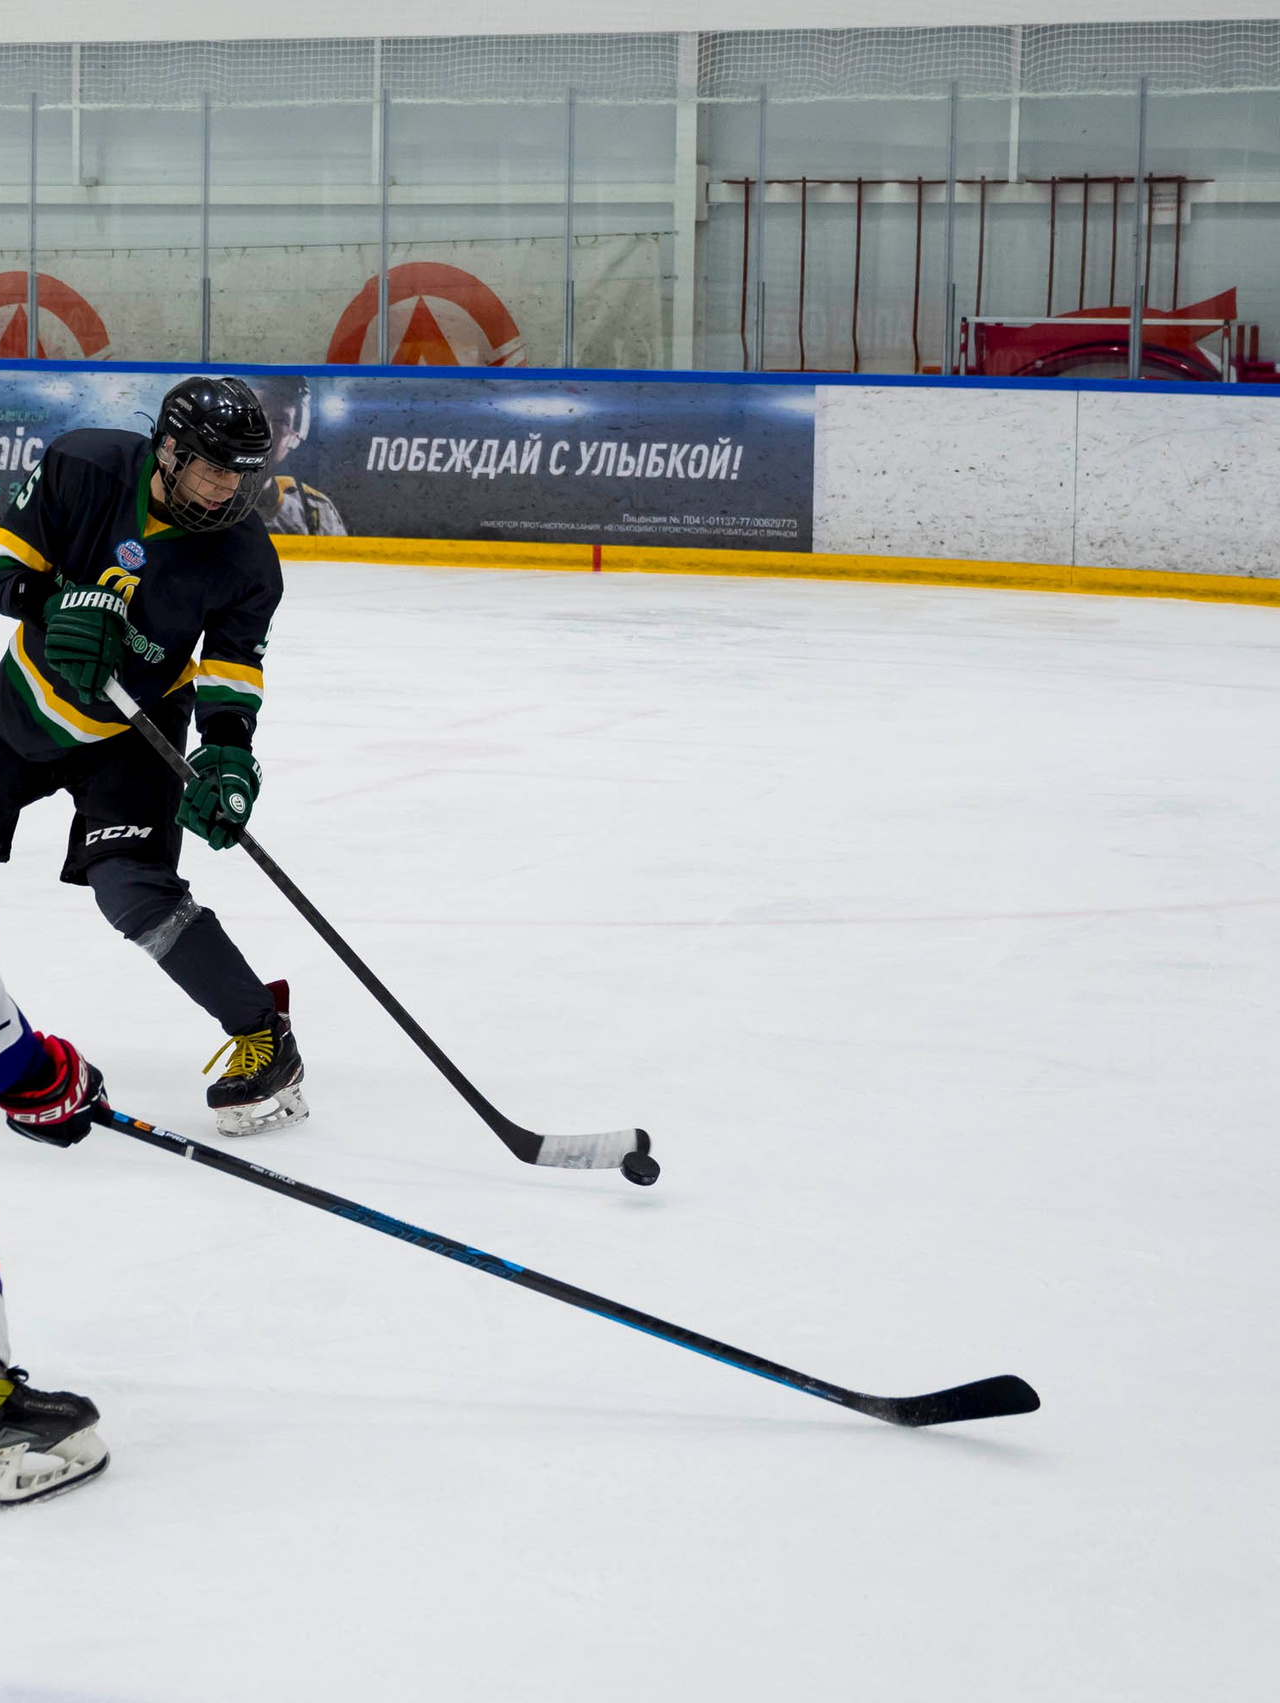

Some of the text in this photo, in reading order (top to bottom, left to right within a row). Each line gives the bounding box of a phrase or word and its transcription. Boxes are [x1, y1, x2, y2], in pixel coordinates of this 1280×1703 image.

[234, 455, 264, 464] CCM
[366, 432, 744, 480] ПОБЕЖДАЙ С УЛЫБКОЙ!
[622, 513, 667, 525] Лицензия
[85, 825, 153, 846] CCM
